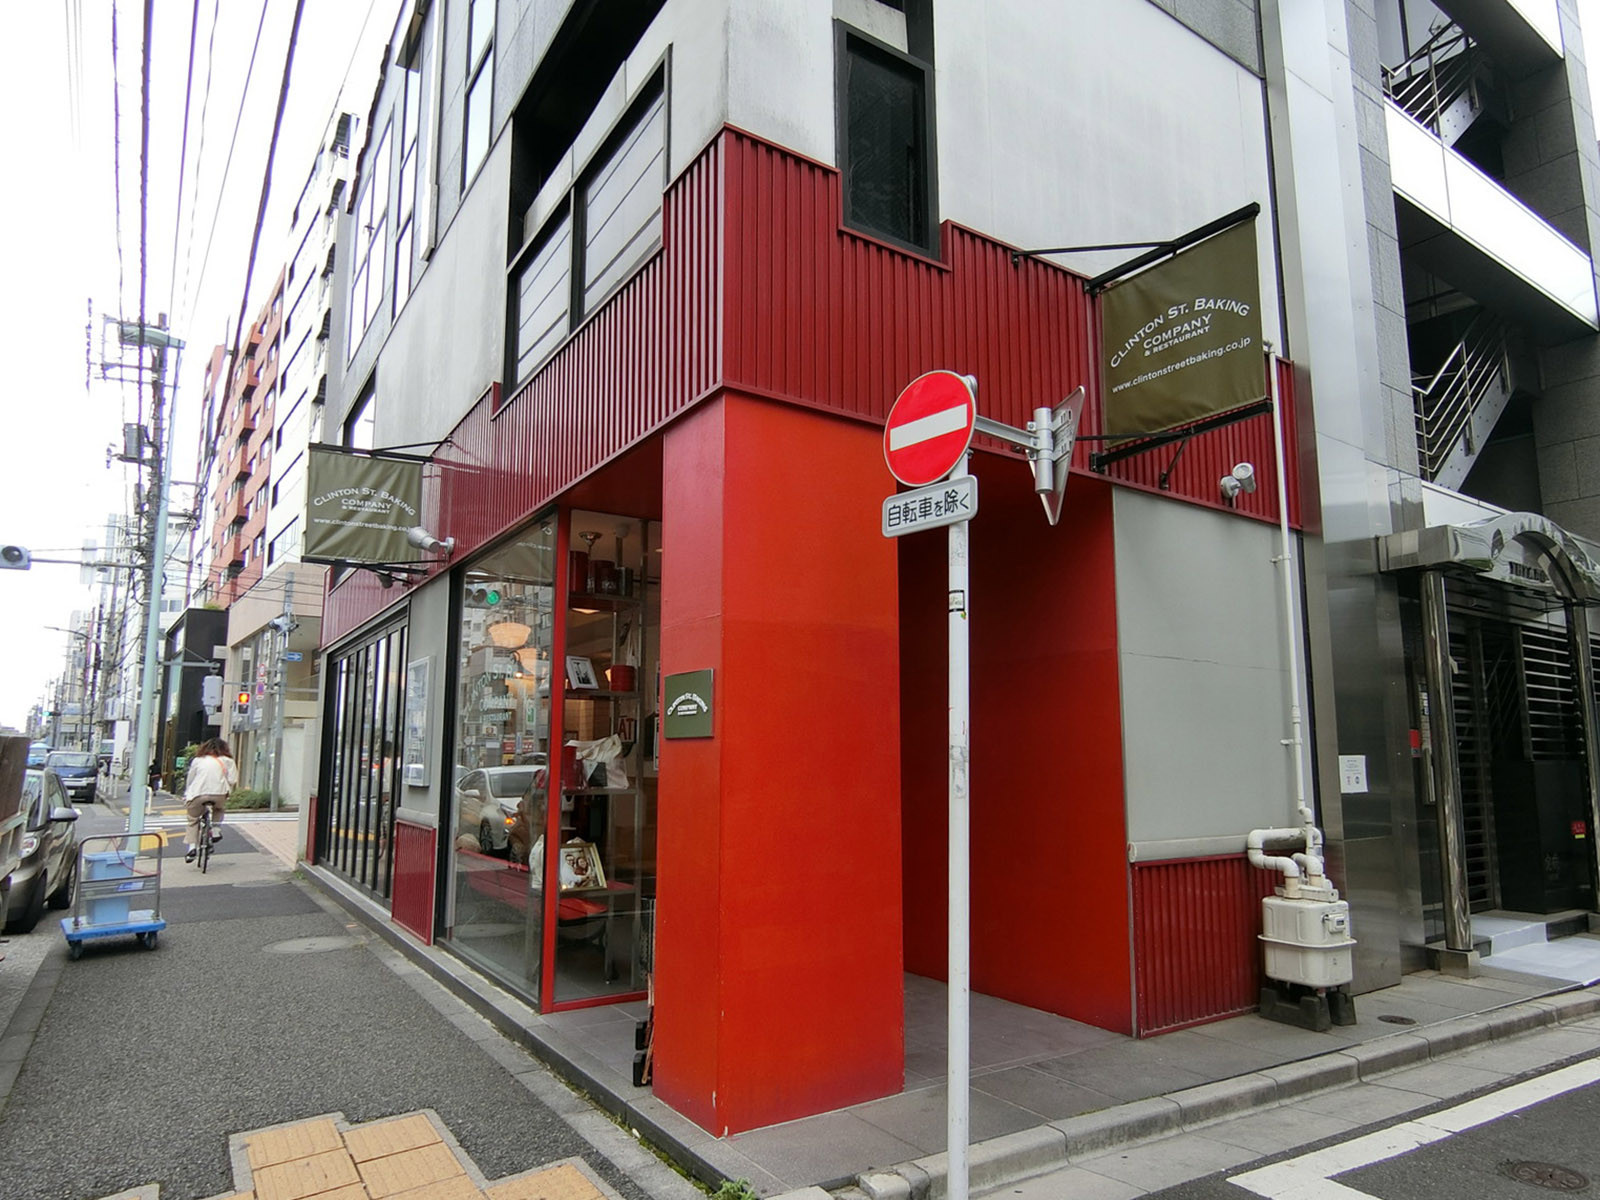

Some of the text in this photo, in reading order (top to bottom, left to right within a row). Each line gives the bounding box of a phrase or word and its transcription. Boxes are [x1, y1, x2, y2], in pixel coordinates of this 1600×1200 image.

[1110, 298, 1250, 368] CLINTON ST. BAKING
[1143, 313, 1212, 349] COMPANY
[1144, 325, 1211, 357] & RESTAURANT
[313, 487, 416, 516] CLINTON ST. BAKING
[341, 498, 392, 510] COMPANY
[888, 489, 969, 528] 自転車を除く
